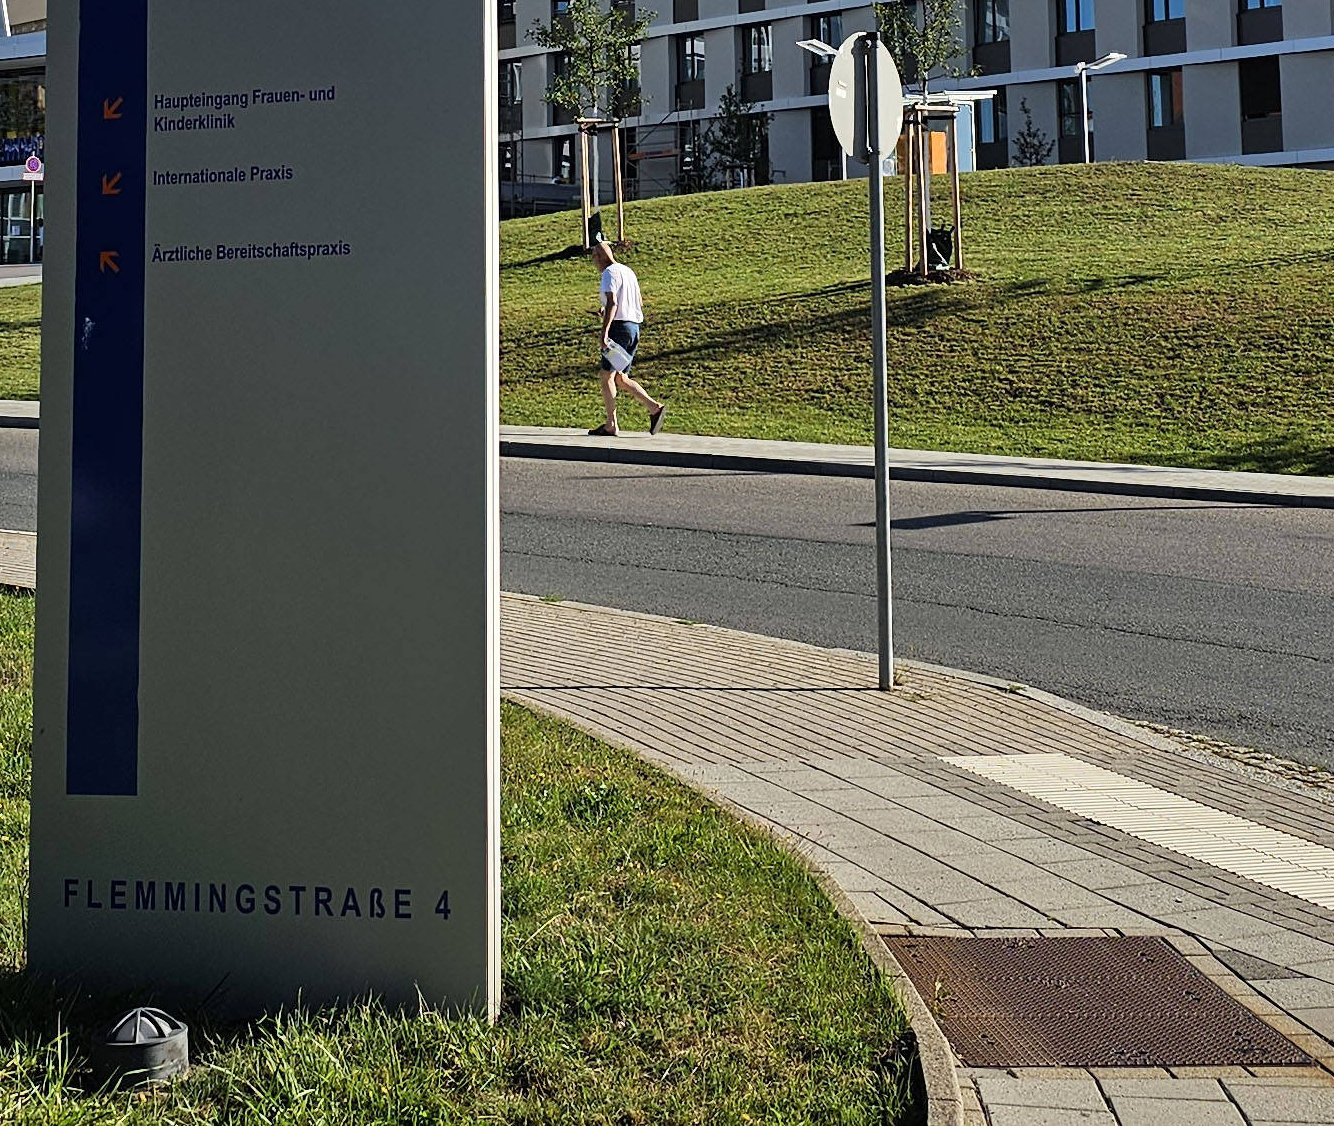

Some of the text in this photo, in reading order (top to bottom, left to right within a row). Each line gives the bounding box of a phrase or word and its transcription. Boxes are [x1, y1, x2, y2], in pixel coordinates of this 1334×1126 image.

[154, 86, 335, 112] Haupteingang Frauen- und
[154, 113, 236, 132] Kinderklinik
[153, 164, 294, 186] Internationale Praxis
[151, 240, 352, 263] Ärztliche Bereitschaftspraxis
[434, 889, 452, 921] 4
